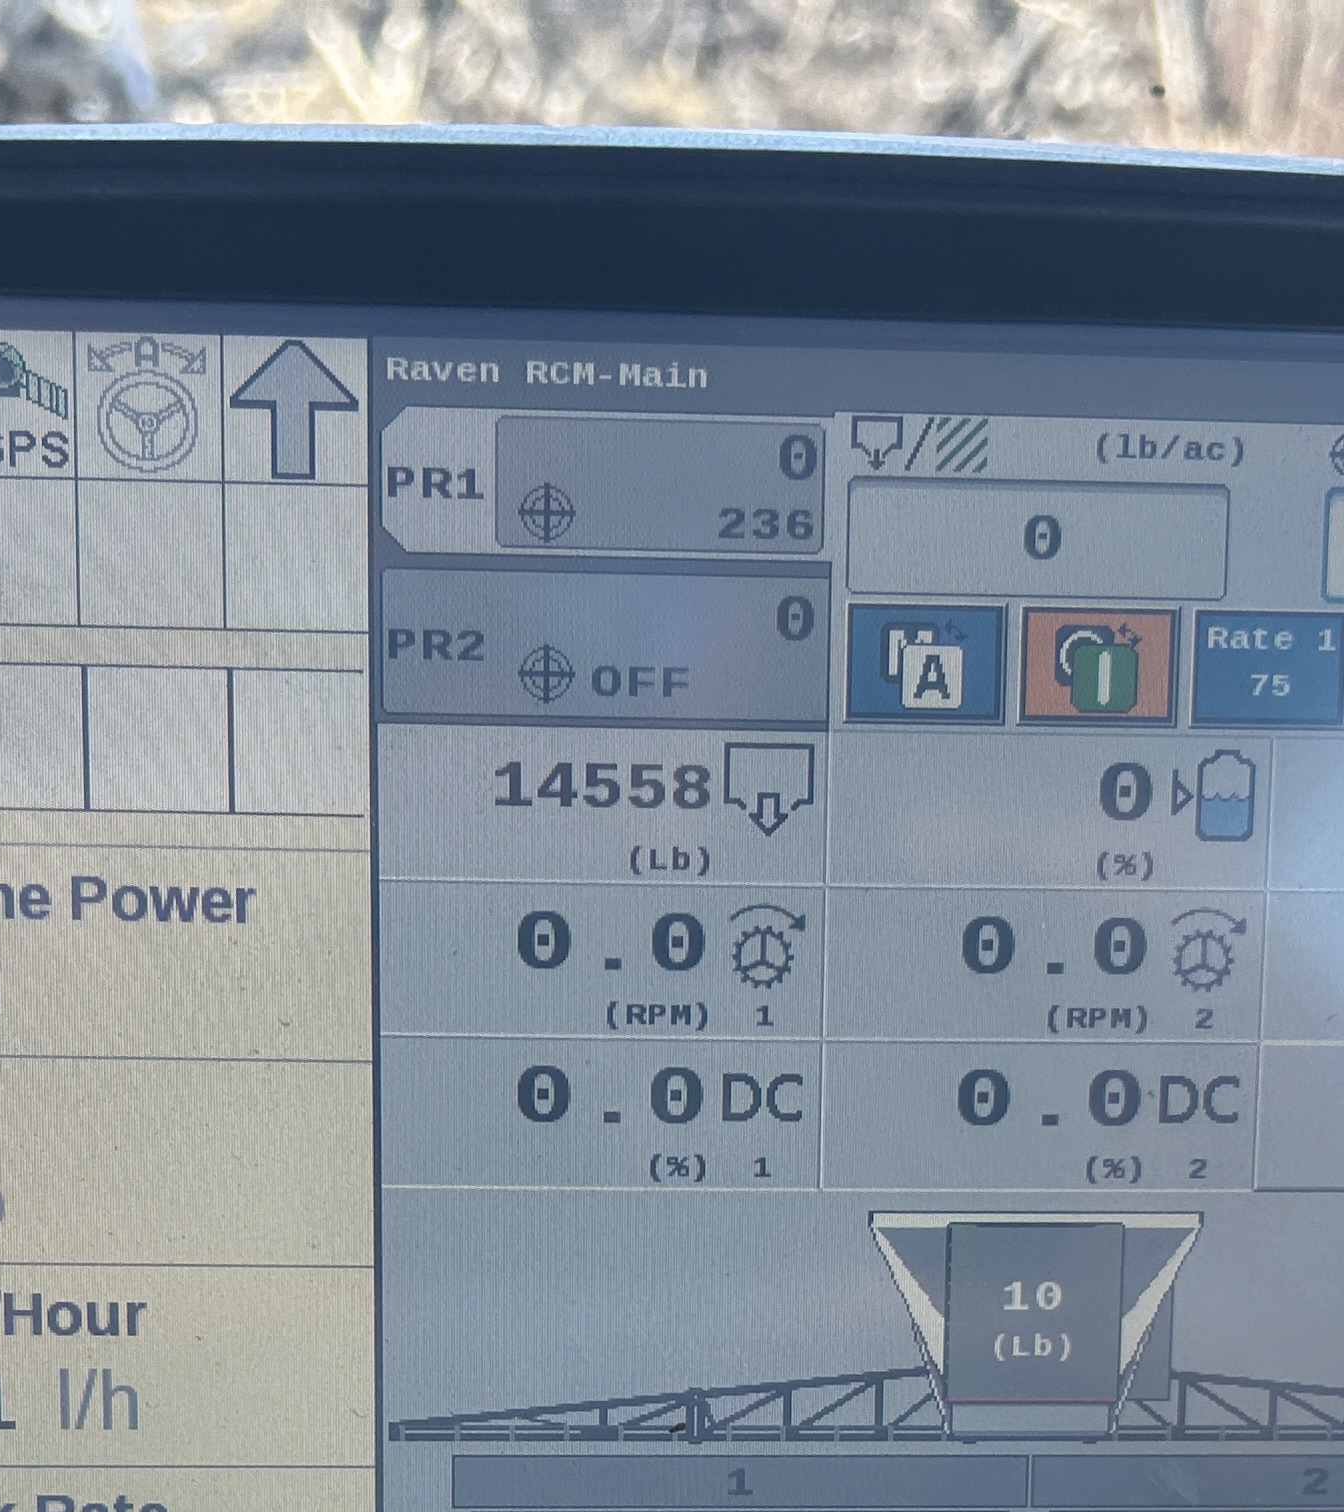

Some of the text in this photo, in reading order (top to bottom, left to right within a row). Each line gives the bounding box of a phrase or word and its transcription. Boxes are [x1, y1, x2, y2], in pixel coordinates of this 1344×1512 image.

[386, 356, 709, 389] Raven RCM-Main
[779, 435, 819, 480] 0
[1095, 434, 1246, 467] (lb/ac)
[386, 466, 485, 501] PR1
[718, 508, 816, 541] 236
[1023, 514, 1062, 560] 0
[776, 596, 816, 642] 0
[386, 627, 486, 662] PR2
[1207, 625, 1337, 653] Rate 1
[591, 665, 692, 698] OFF
[1249, 673, 1293, 699] 75
[494, 760, 712, 810] 14558
[1099, 761, 1154, 822] 0
[628, 845, 712, 876] (Lb)
[1096, 852, 1155, 882] (%)
[70, 875, 257, 926] Power
[516, 909, 707, 973] 0.0
[961, 915, 1148, 977] 0.0
[605, 1000, 775, 1031] (RPM) 1
[1046, 1004, 1215, 1033] (RPM) 2
[516, 1064, 805, 1126] 0.0 DC
[957, 1067, 1242, 1128] 0.0 DC
[648, 1154, 772, 1183] (%) 1
[1085, 1155, 1209, 1185] (%) 2
[1002, 1280, 1063, 1312] 10
[994, 1332, 1073, 1362] (Lb)
[58, 1367, 140, 1431] l/h
[727, 1466, 755, 1498] 1
[1301, 1466, 1331, 1497] 2
